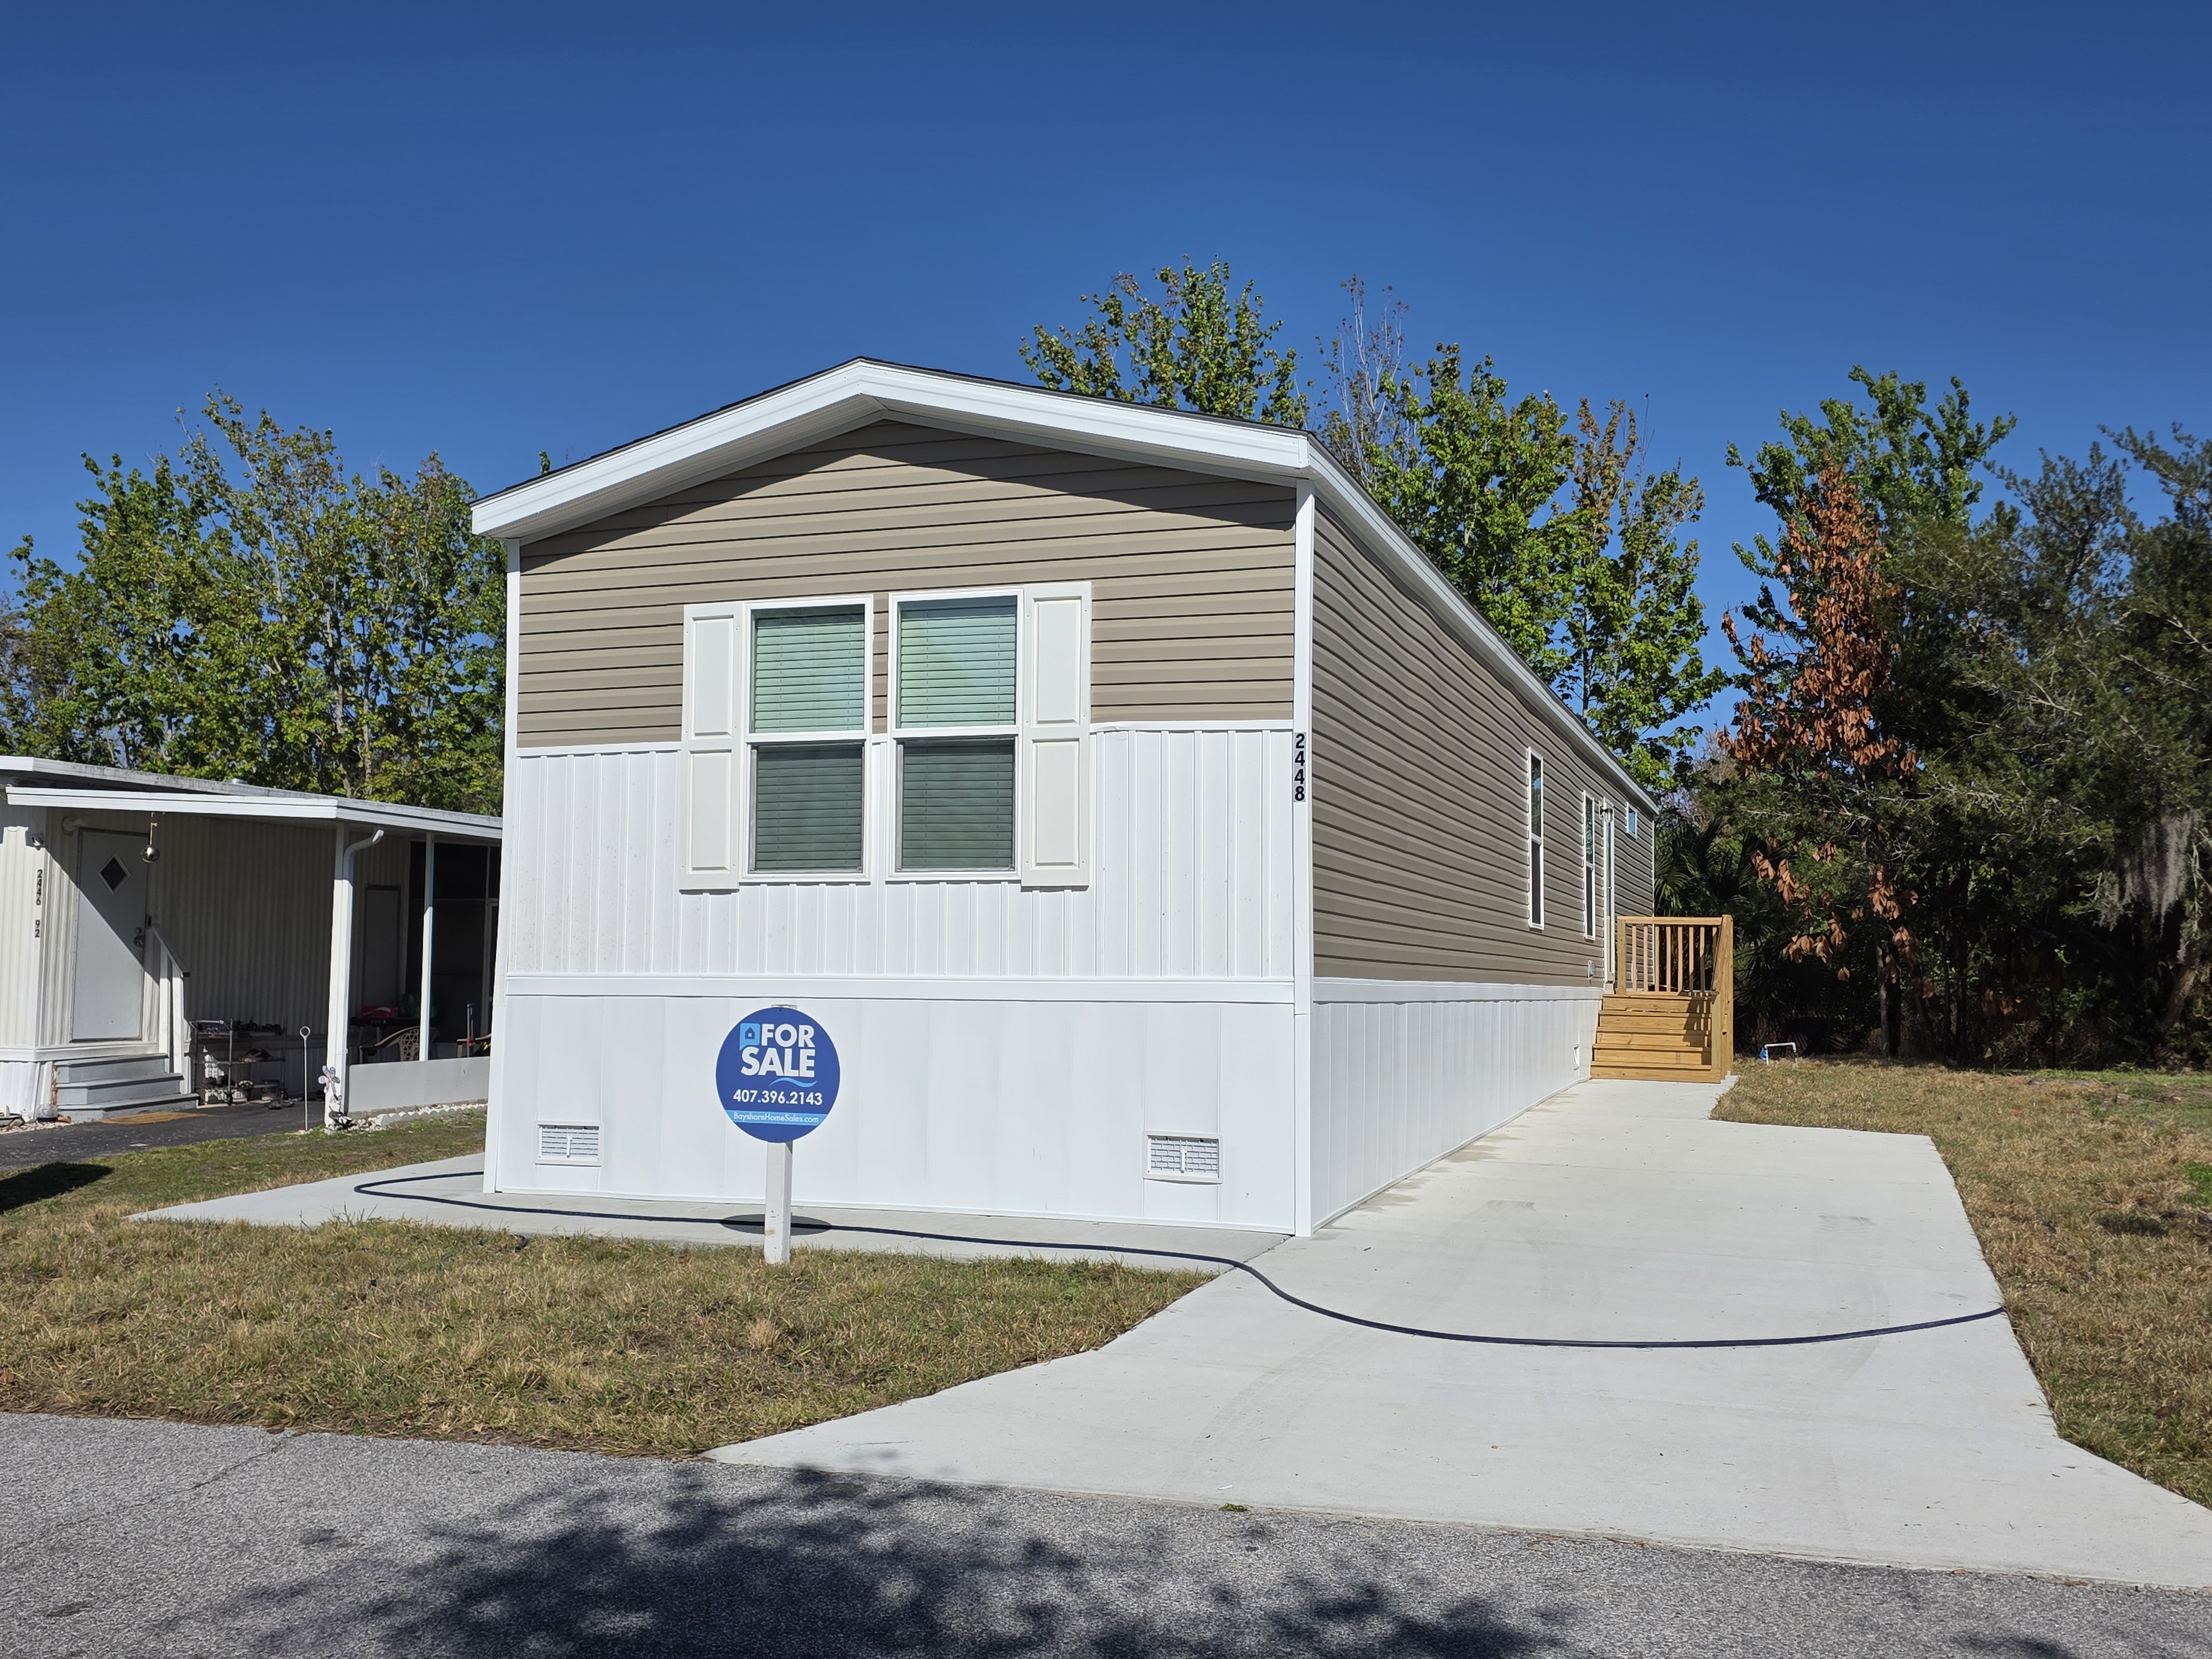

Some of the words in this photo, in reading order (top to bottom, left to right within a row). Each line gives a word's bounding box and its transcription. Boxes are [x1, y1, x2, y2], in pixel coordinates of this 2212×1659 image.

[1295, 733, 1305, 801] 2448
[35, 920, 40, 937] 92
[761, 1024, 816, 1047] FOR
[740, 1046, 816, 1078] SALE
[733, 1089, 822, 1105] 407.396.2143
[733, 1112, 819, 1123] BayshoreHomeSales.com
